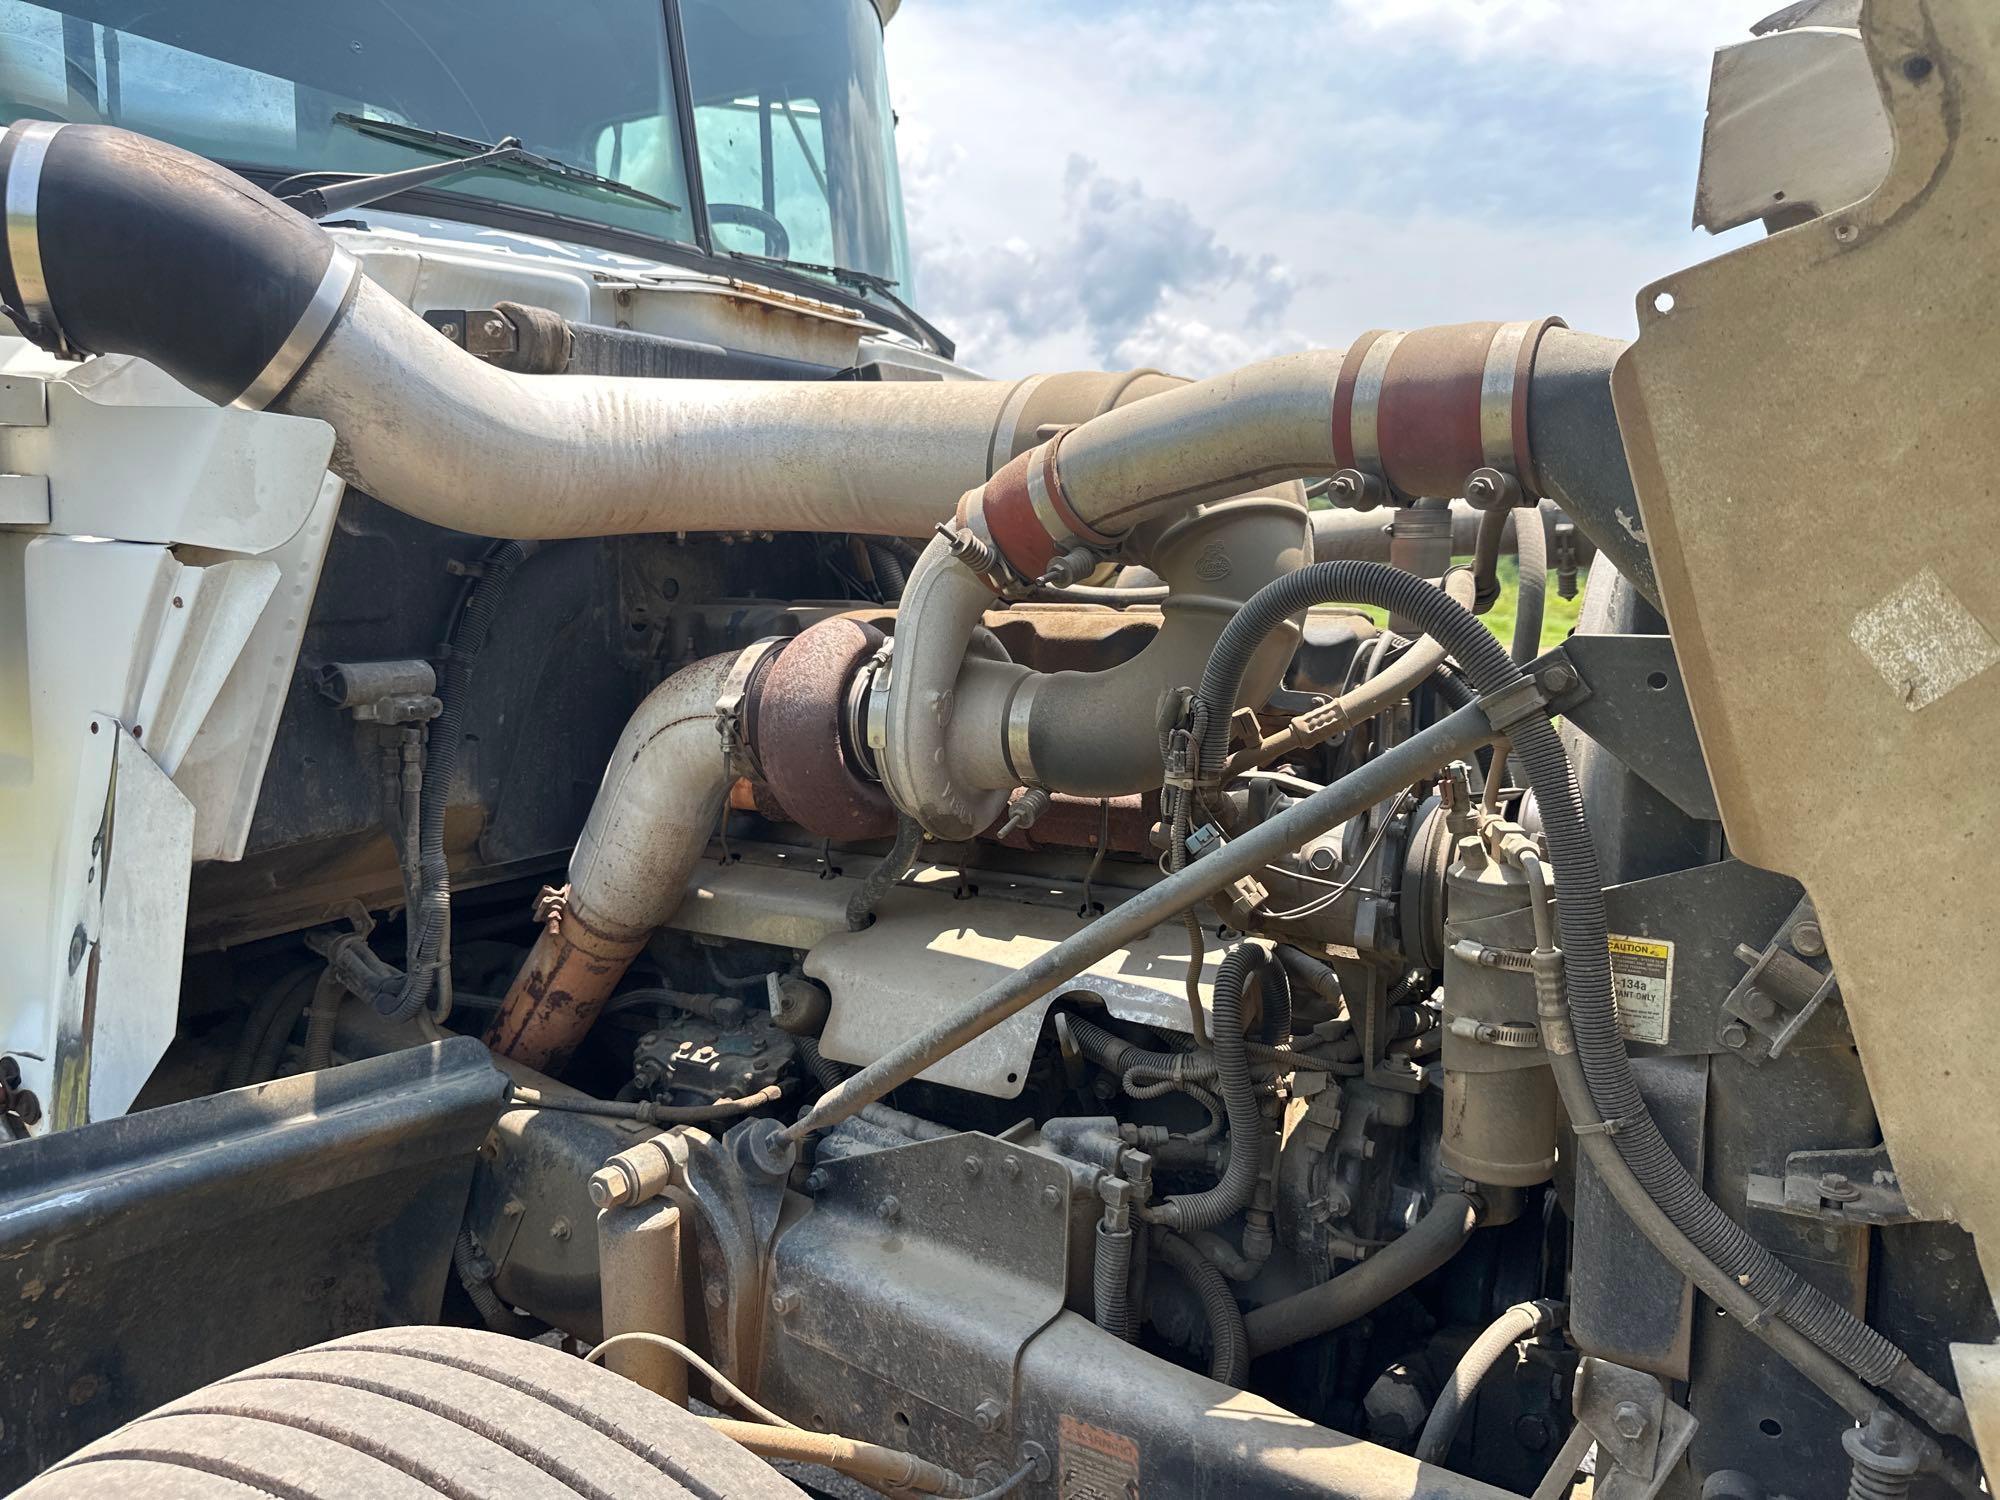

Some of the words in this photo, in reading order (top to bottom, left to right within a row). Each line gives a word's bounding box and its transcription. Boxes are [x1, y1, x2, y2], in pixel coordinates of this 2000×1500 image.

[1608, 942, 1648, 953] CAUTION
[1614, 978, 1647, 991] -134a
[1636, 992, 1656, 1003] ONLY
